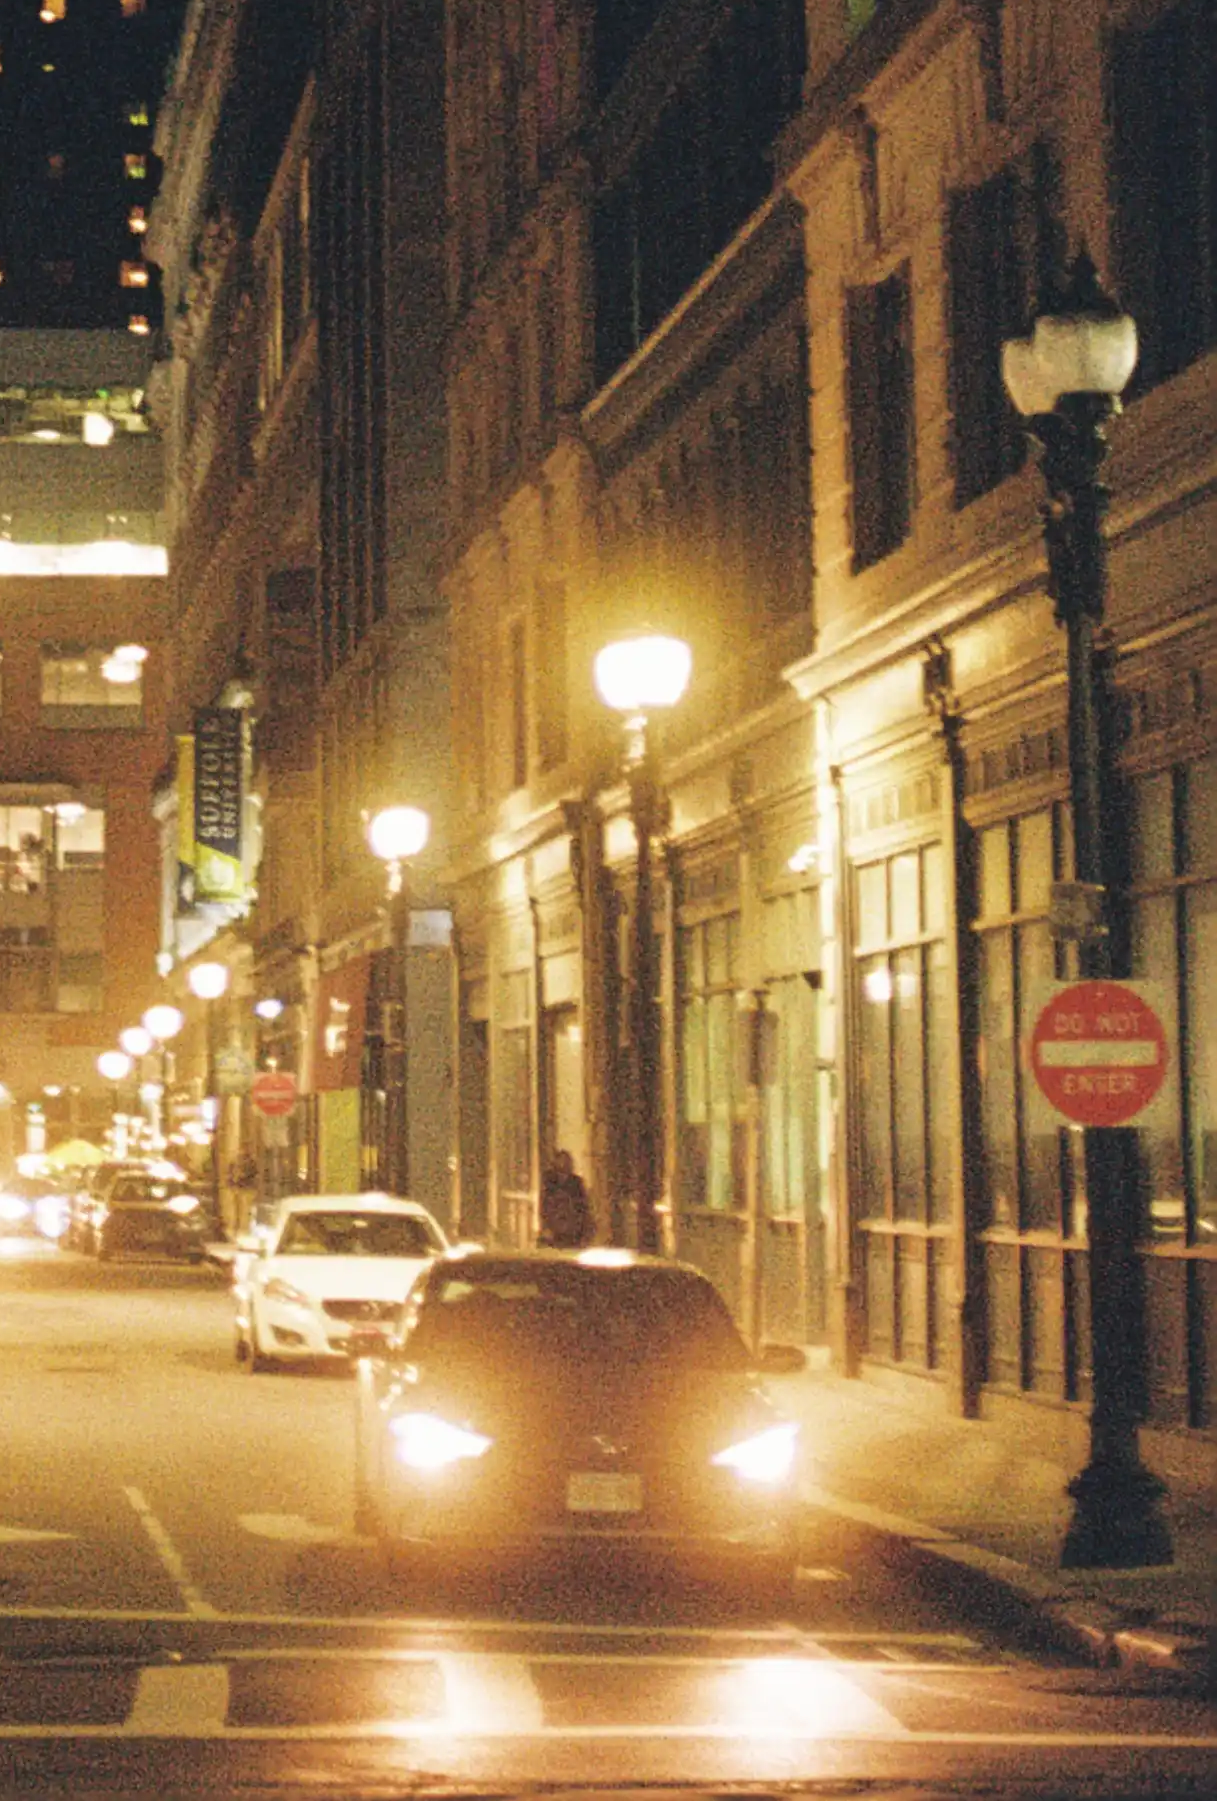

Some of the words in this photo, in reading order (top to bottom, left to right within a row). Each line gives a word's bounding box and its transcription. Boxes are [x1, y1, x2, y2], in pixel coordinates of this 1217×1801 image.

[1054, 1012, 1083, 1034] DO
[1097, 1011, 1143, 1033] NOT
[1062, 1073, 1139, 1094] ENTER
